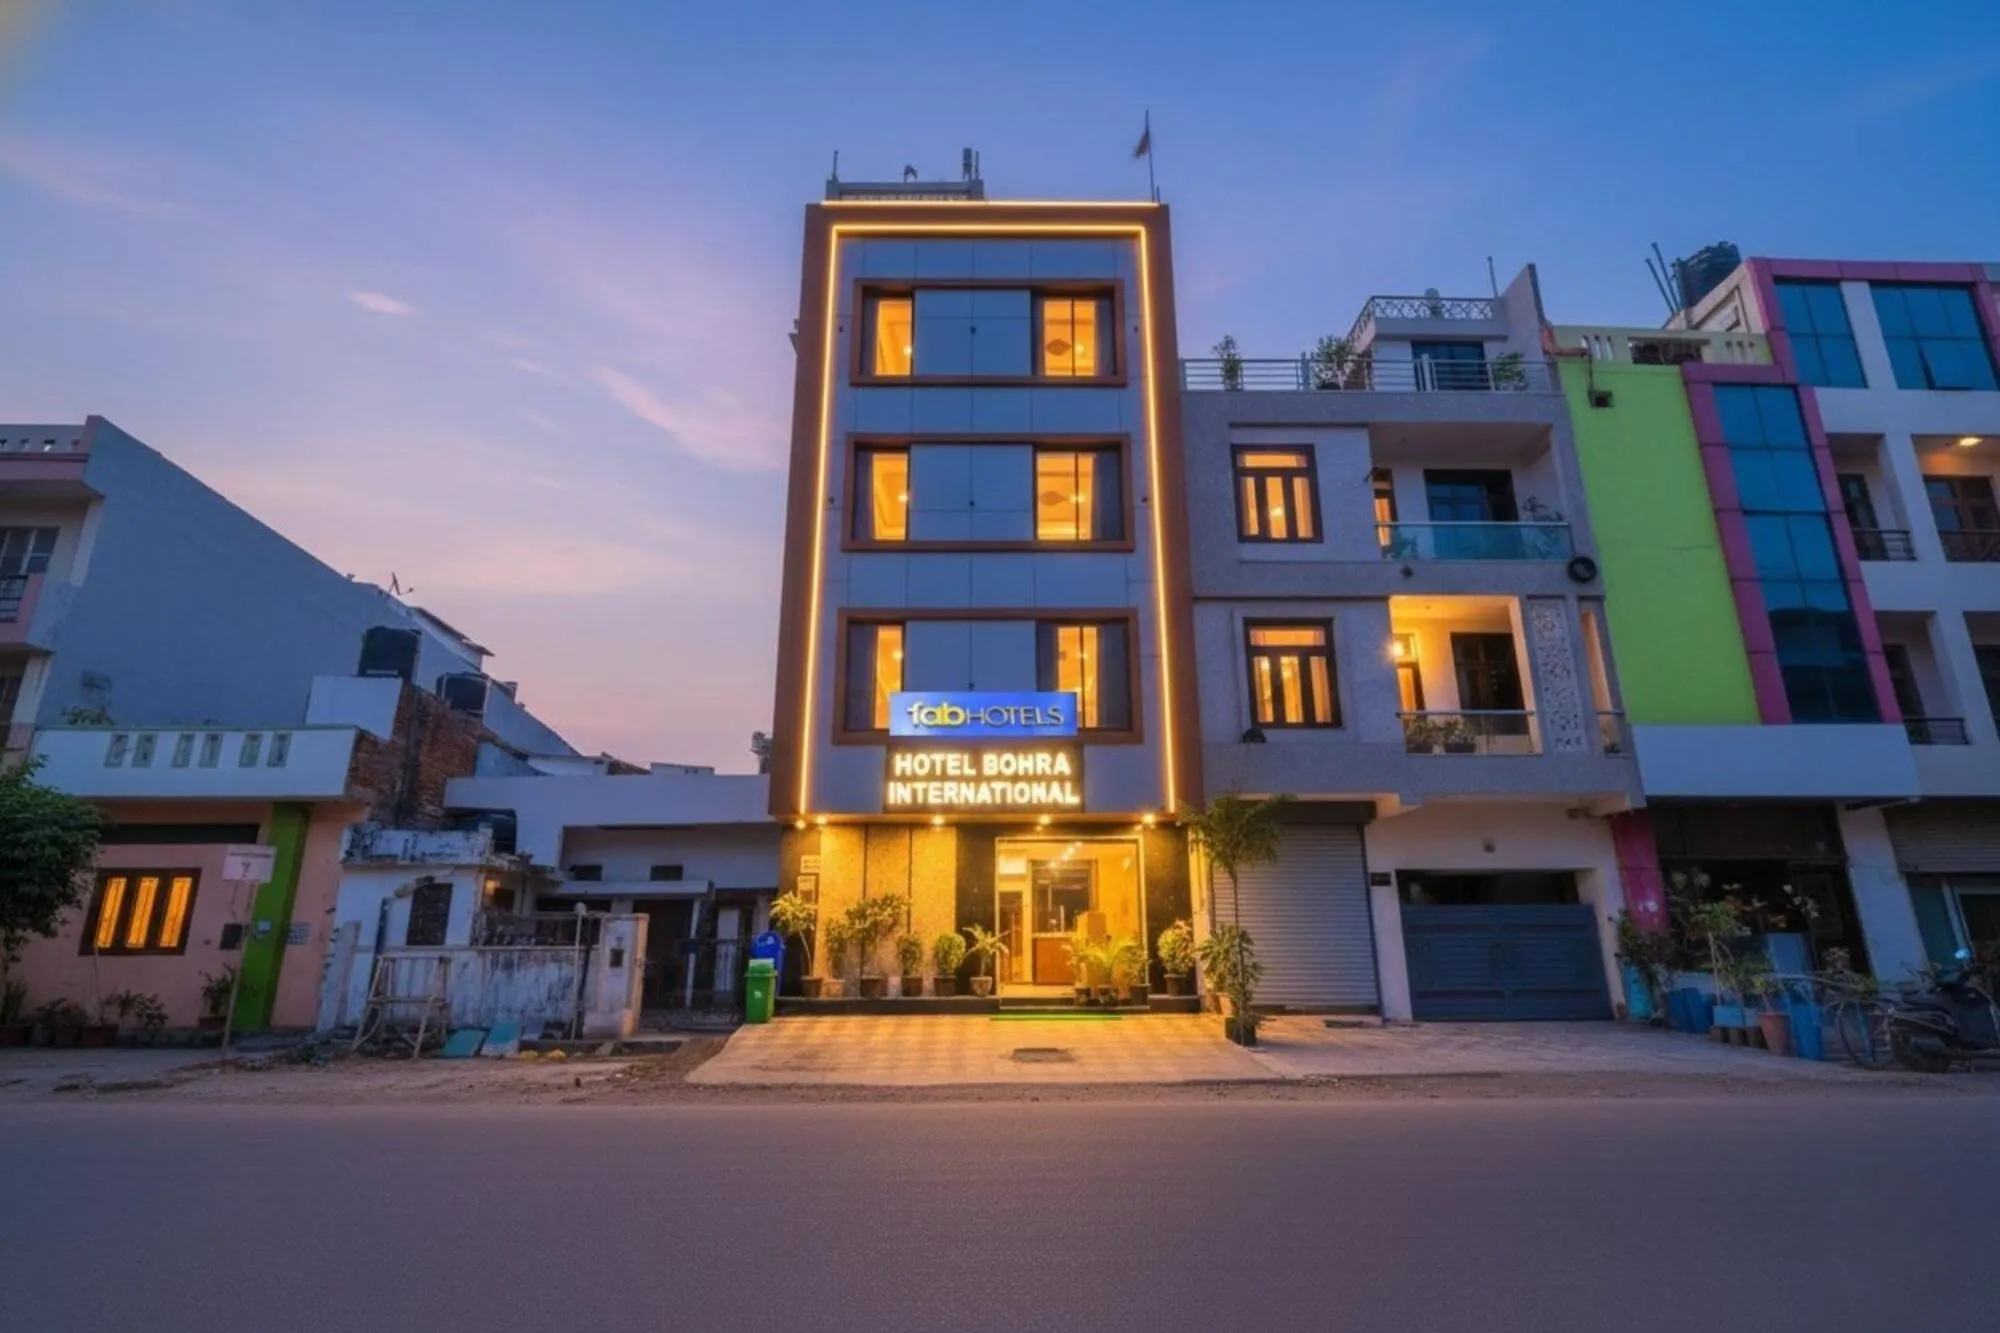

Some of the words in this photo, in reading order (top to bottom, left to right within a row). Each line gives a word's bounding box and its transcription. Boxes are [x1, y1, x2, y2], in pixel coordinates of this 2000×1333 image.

[894, 753, 977, 776] HOTEL
[982, 753, 1071, 776] BOHRA
[888, 782, 1080, 804] INTERNATIONAL
